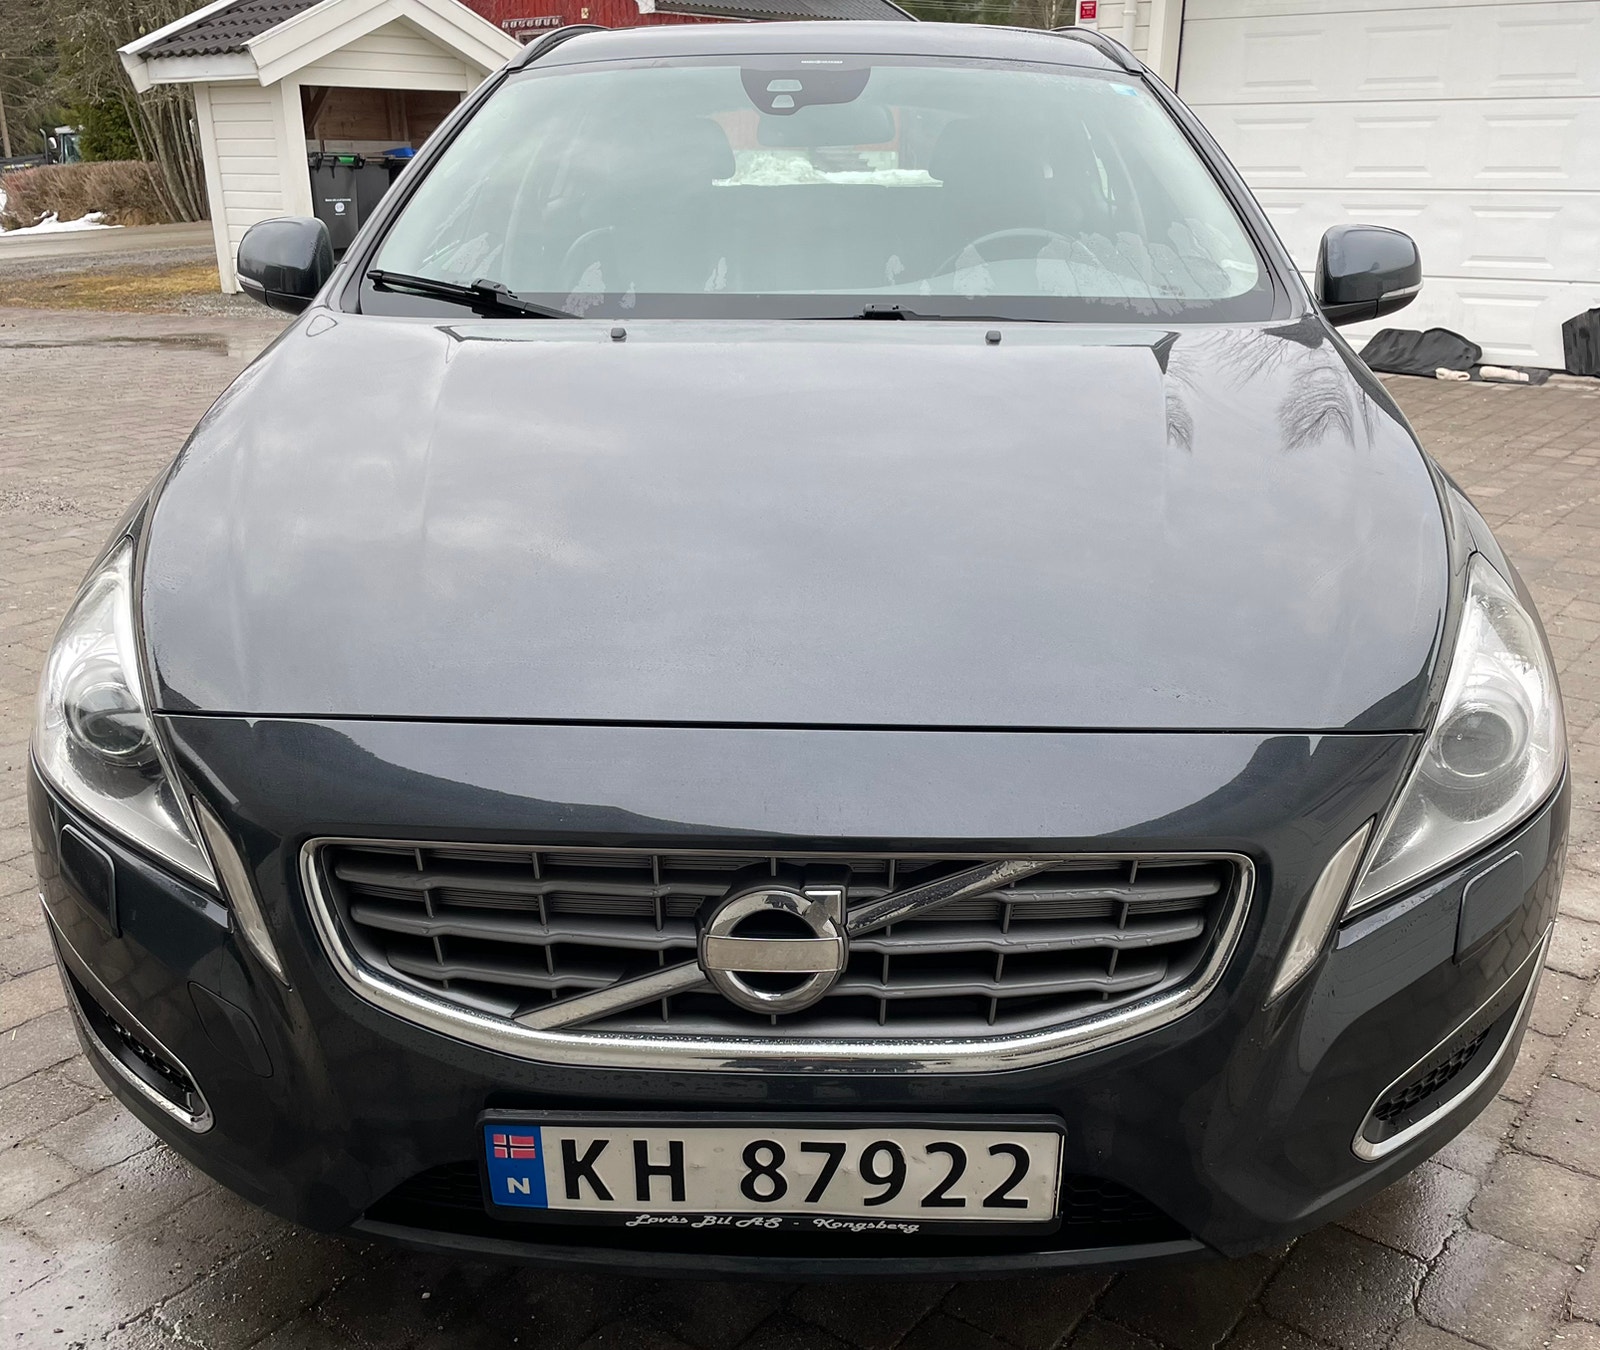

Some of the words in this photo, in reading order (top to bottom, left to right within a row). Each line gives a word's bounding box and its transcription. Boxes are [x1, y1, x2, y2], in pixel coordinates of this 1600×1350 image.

[561, 1138, 687, 1202] KH
[740, 1139, 1030, 1209] 87922
[507, 1177, 531, 1195] N
[691, 1215, 733, 1228] Bil
[735, 1217, 783, 1229] AS
[812, 1218, 920, 1234] Kongsberg
